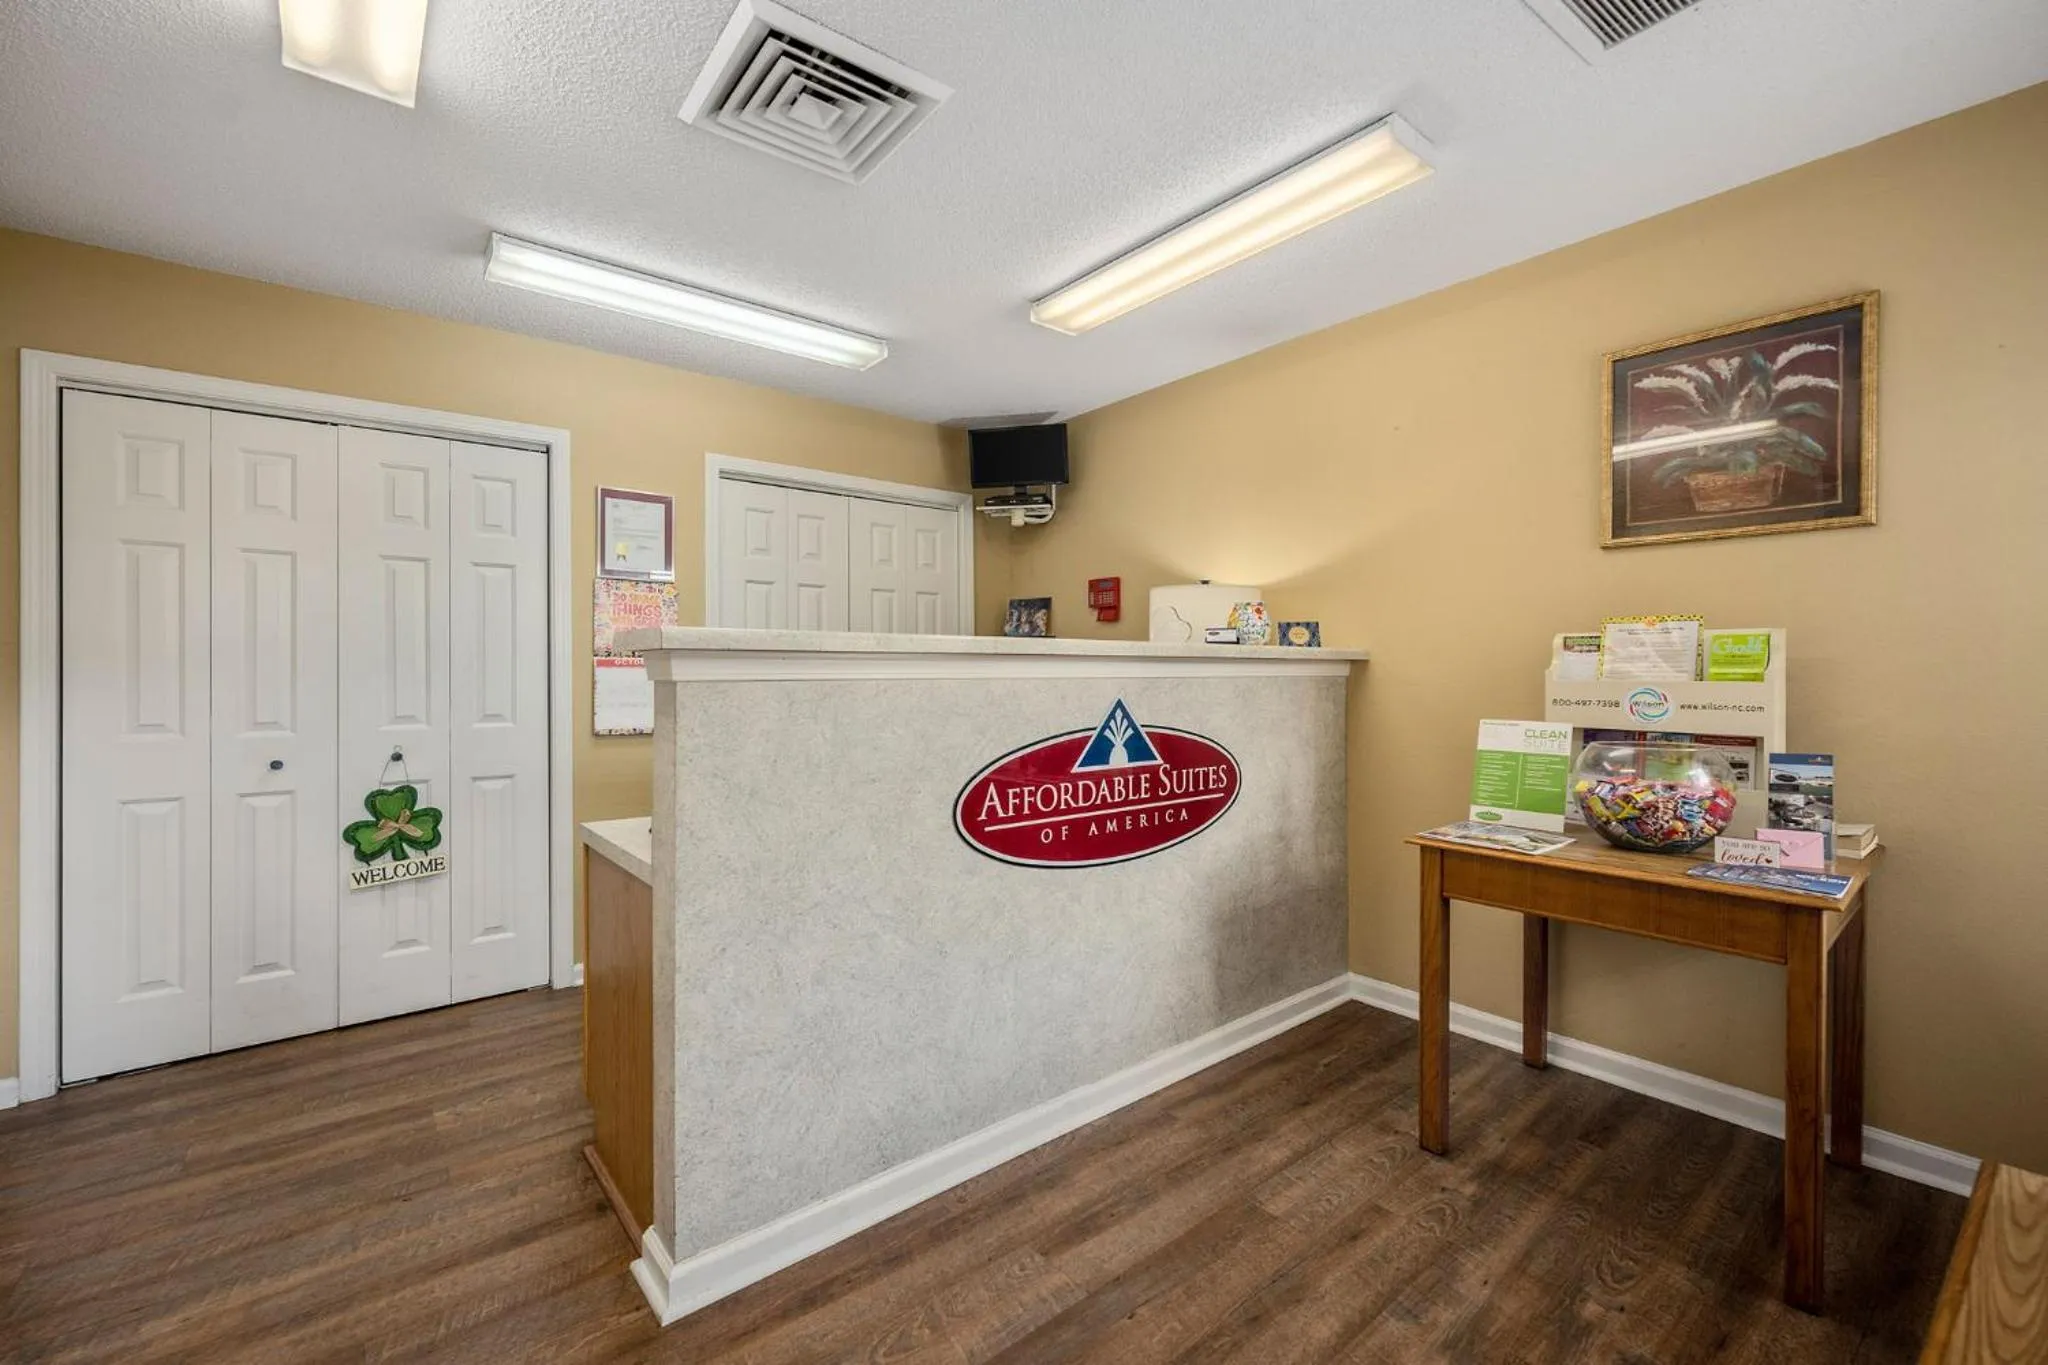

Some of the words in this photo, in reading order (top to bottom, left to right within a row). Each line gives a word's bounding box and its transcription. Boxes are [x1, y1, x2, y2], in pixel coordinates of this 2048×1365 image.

[612, 603, 662, 618] THINGS
[1551, 698, 1621, 709] 800-497-7398
[1679, 701, 1765, 713] www.wilson-nc.com
[1524, 728, 1568, 740] CLEAN
[977, 773, 1151, 821] AFFORDABLE
[1158, 763, 1228, 796] SUITES
[1040, 824, 1070, 844] OF
[1087, 807, 1190, 837] AMERICA
[1721, 848, 1764, 865] loved
[351, 856, 446, 886] WELCOME
